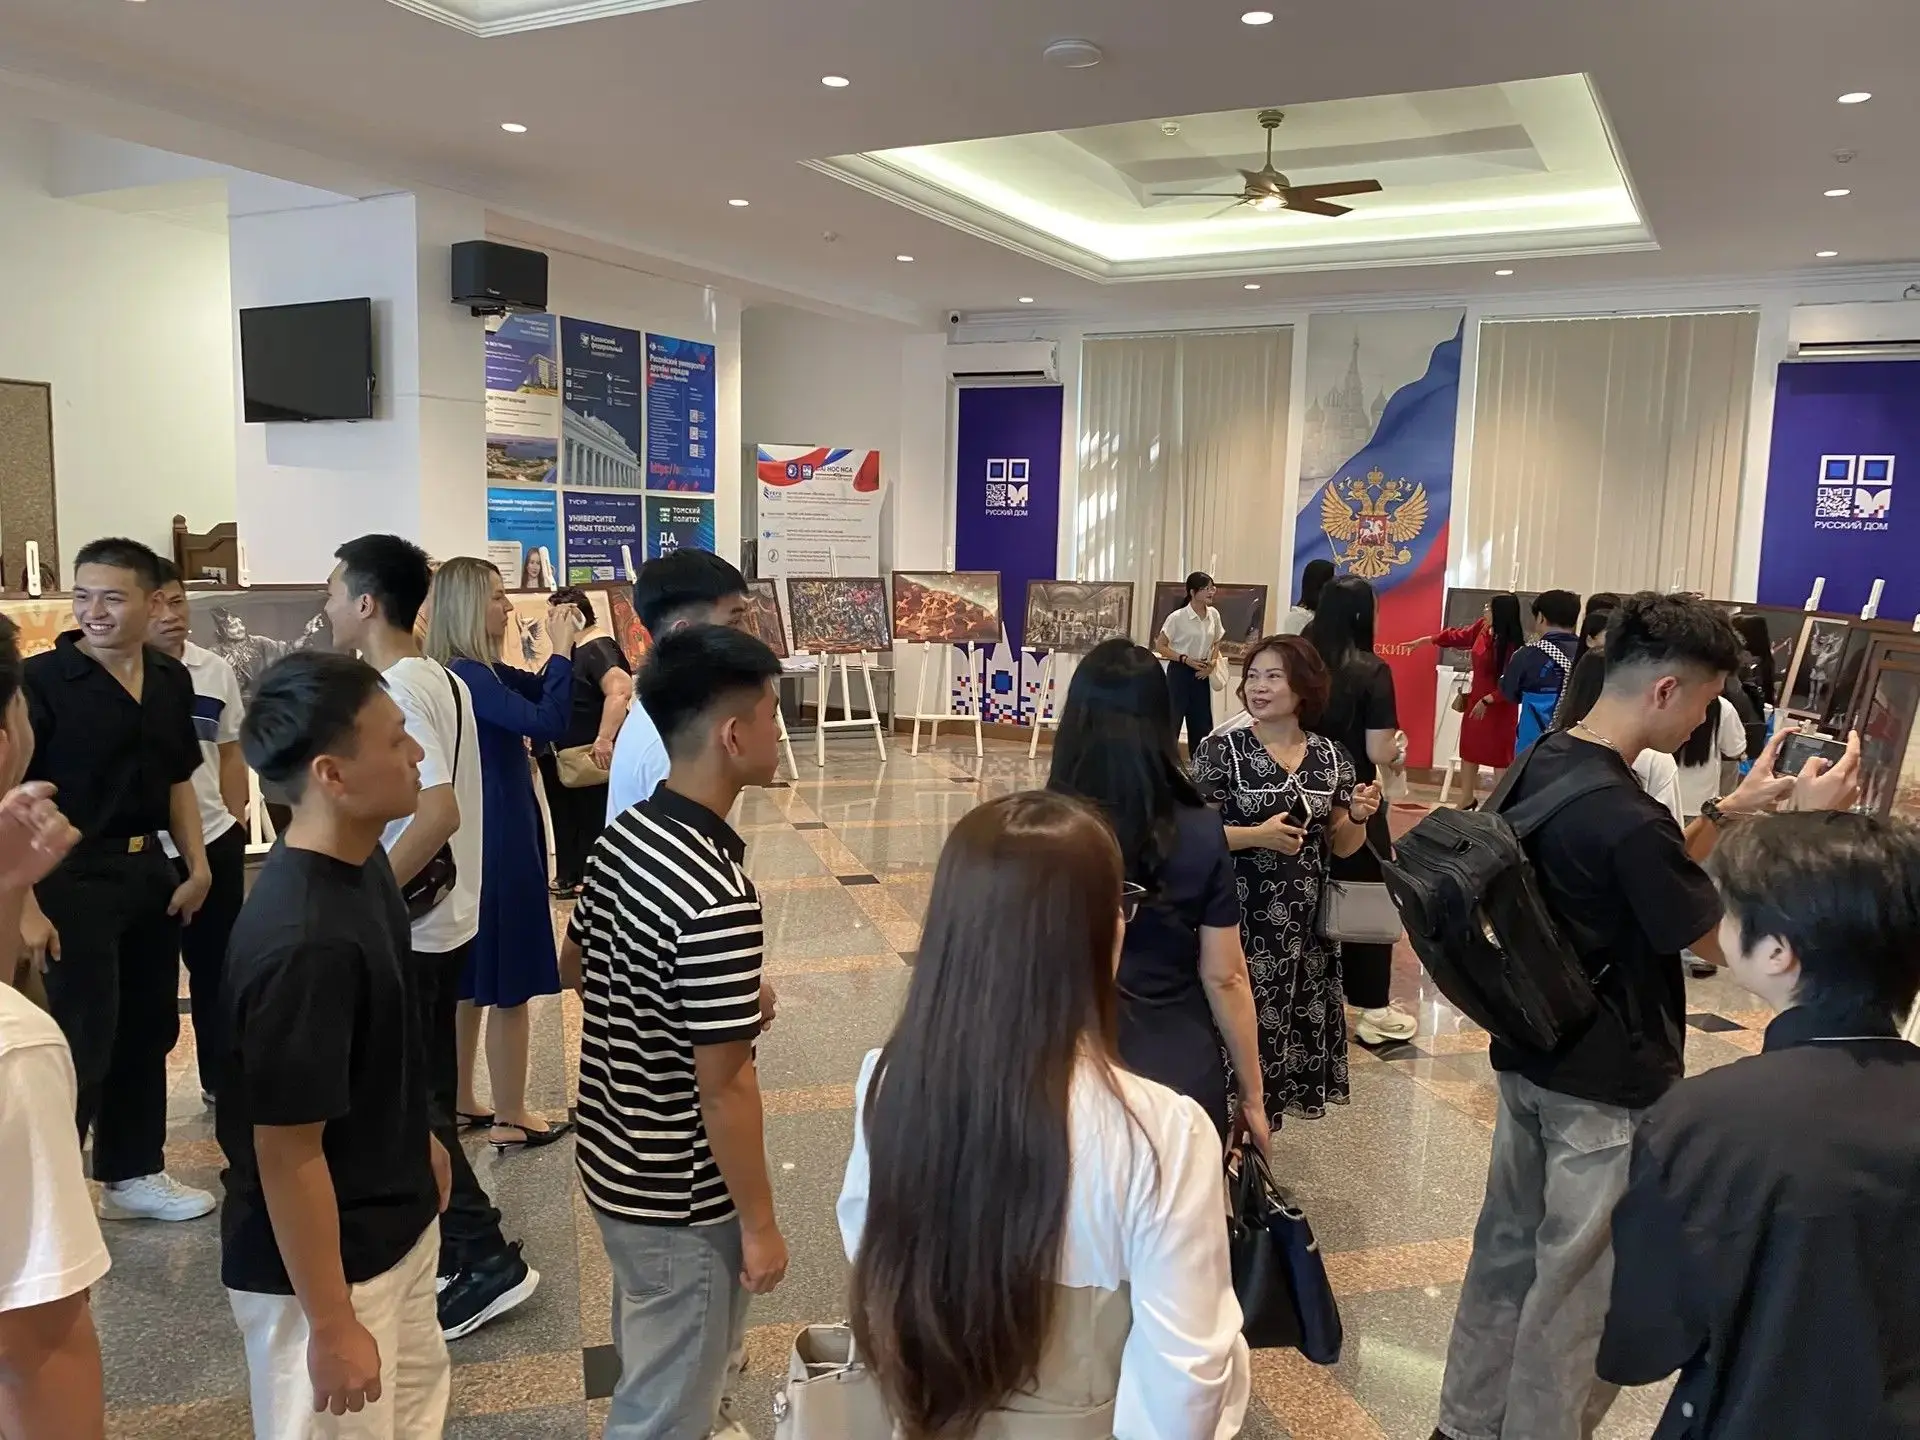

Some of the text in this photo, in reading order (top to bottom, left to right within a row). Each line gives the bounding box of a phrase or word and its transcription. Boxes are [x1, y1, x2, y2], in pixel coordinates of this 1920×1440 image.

[672, 506, 700, 515] ТОМСКИЙ
[985, 508, 1029, 517] РУССКИЙ ДОМ
[568, 514, 617, 524] УНИВЕРСИТЕТ
[672, 516, 700, 524] ПОЛИТЕХ
[568, 524, 636, 533] НОВЫХ ТЕХНОЛОГИЙ
[1814, 520, 1890, 532] РУССКИЙ ДОМ
[660, 532, 678, 546] ДА,
